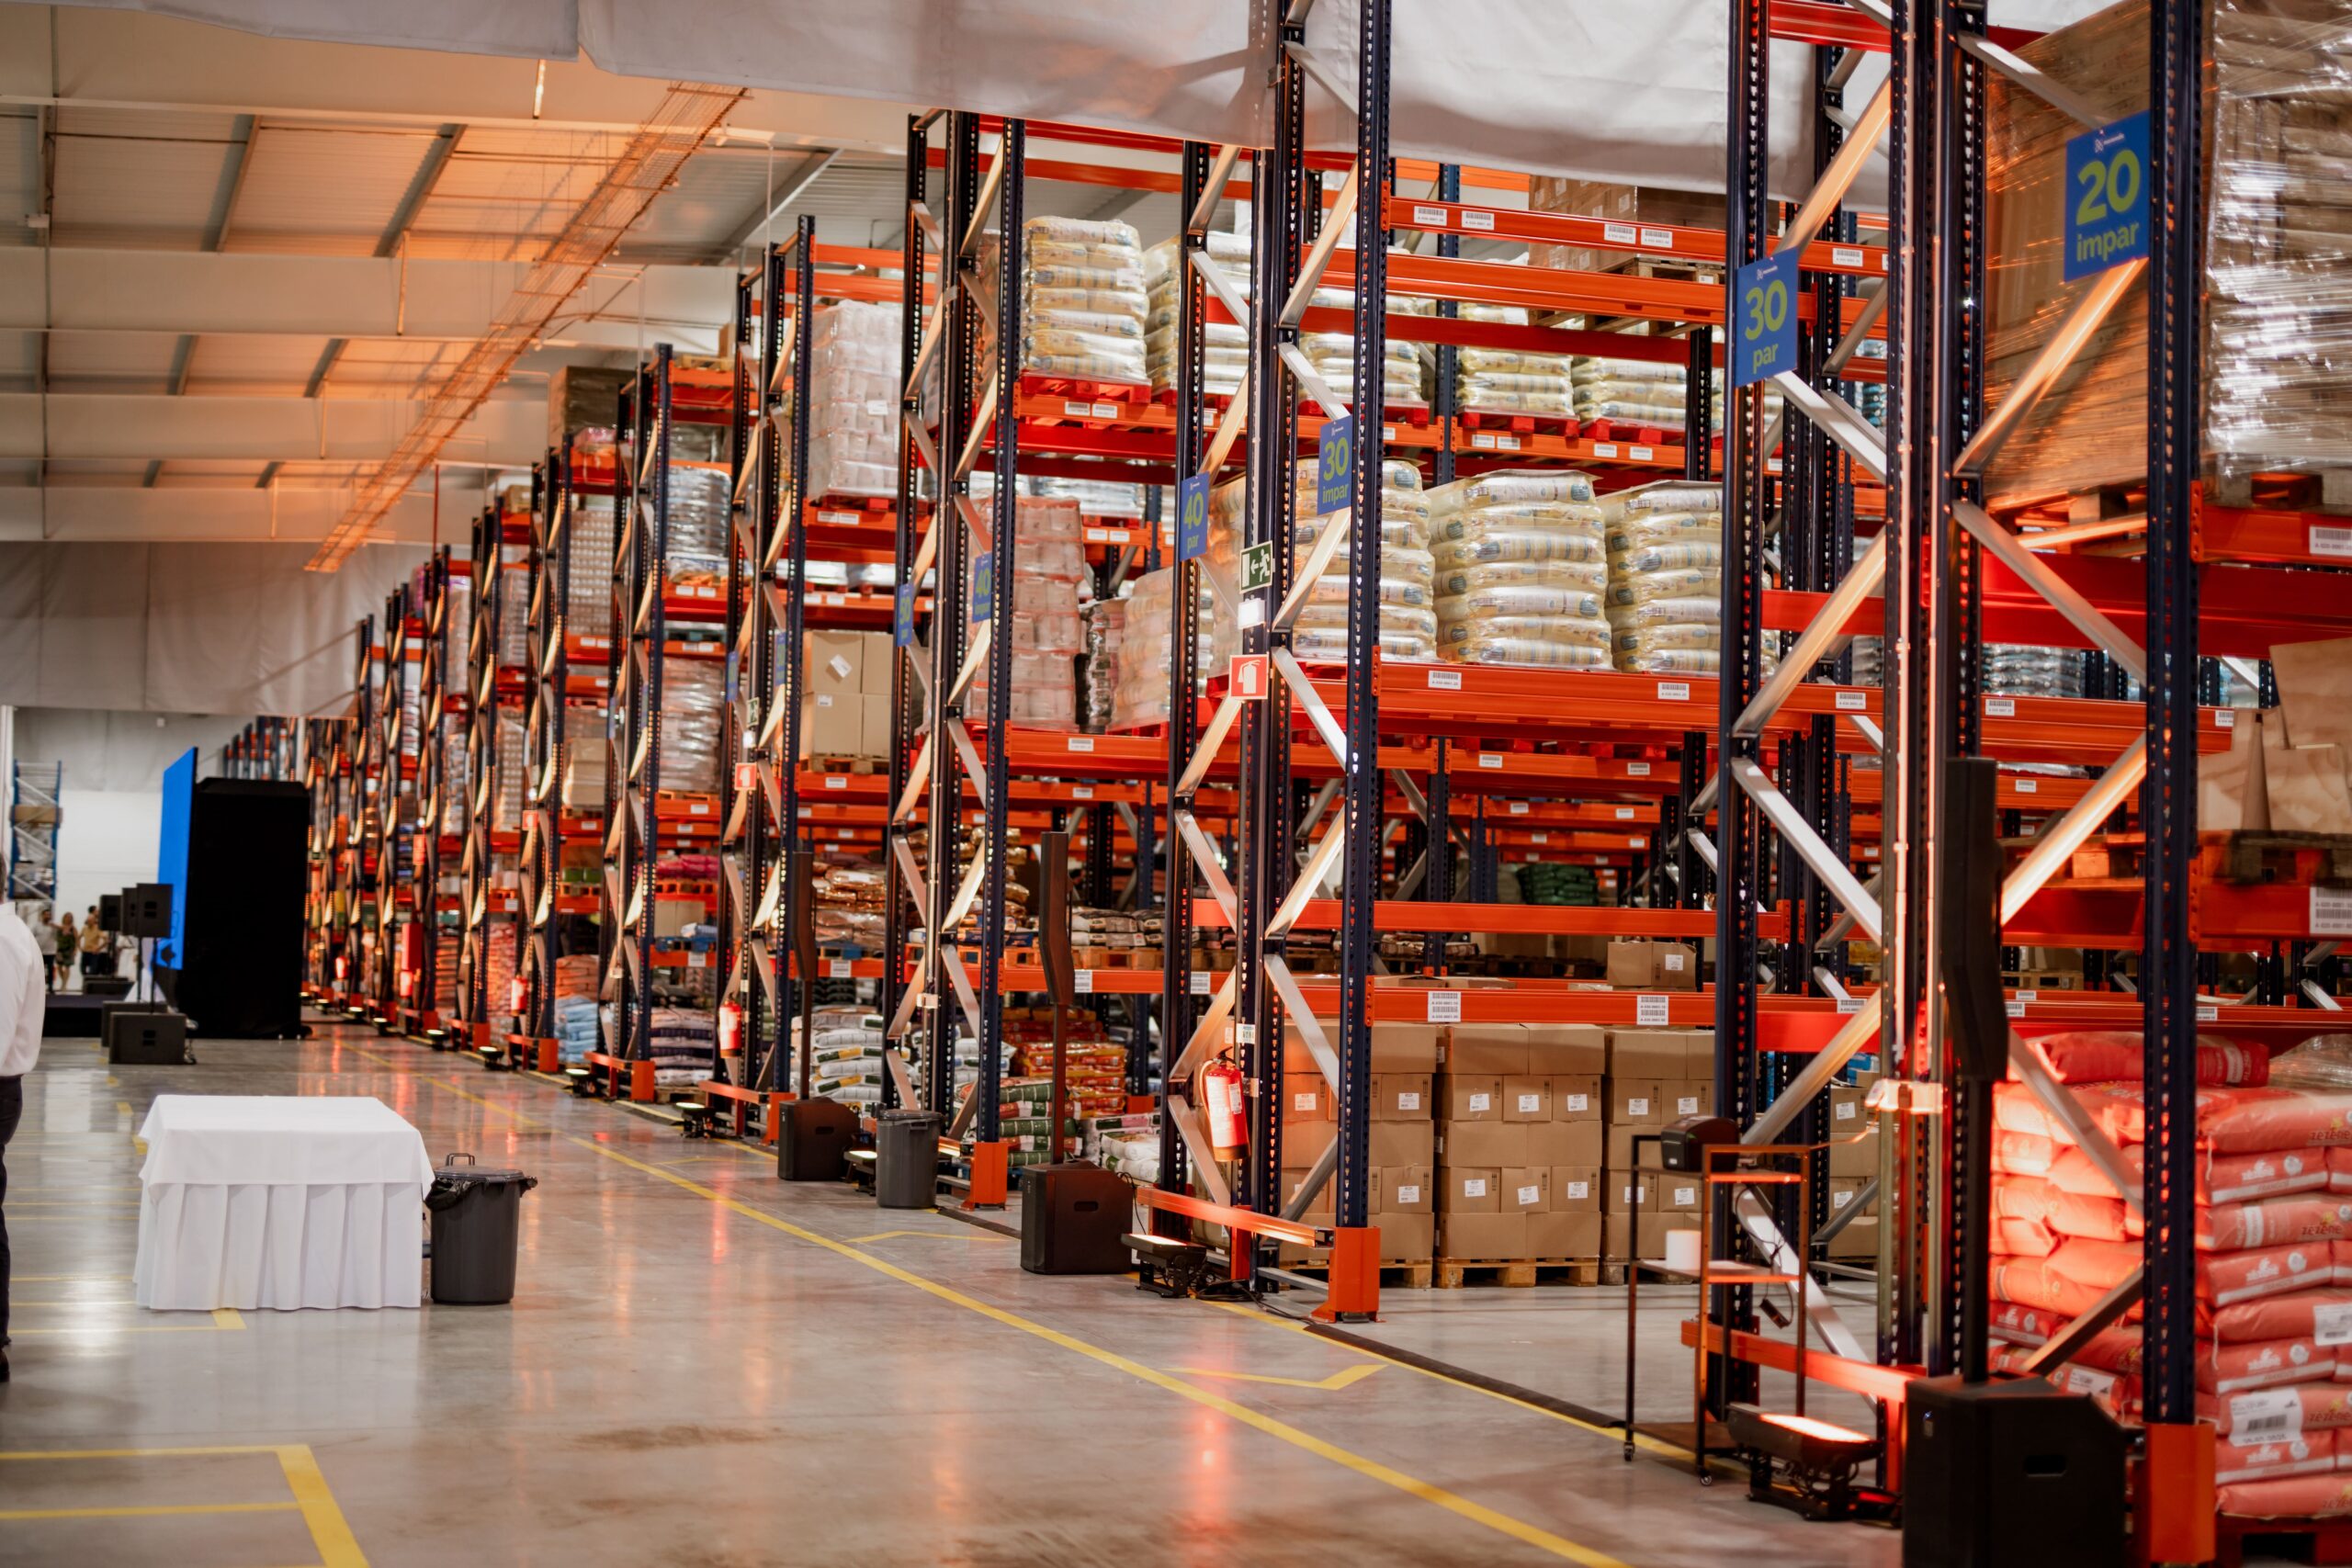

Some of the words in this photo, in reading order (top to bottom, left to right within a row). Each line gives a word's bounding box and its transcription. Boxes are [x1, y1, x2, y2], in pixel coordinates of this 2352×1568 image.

[2075, 149, 2141, 226] 20
[2076, 222, 2140, 263] impar
[1745, 279, 1788, 341] 30
[1752, 343, 1779, 375] par
[1323, 436, 1349, 481] 30
[1183, 491, 1204, 530] 40
[1322, 483, 1350, 505] impar
